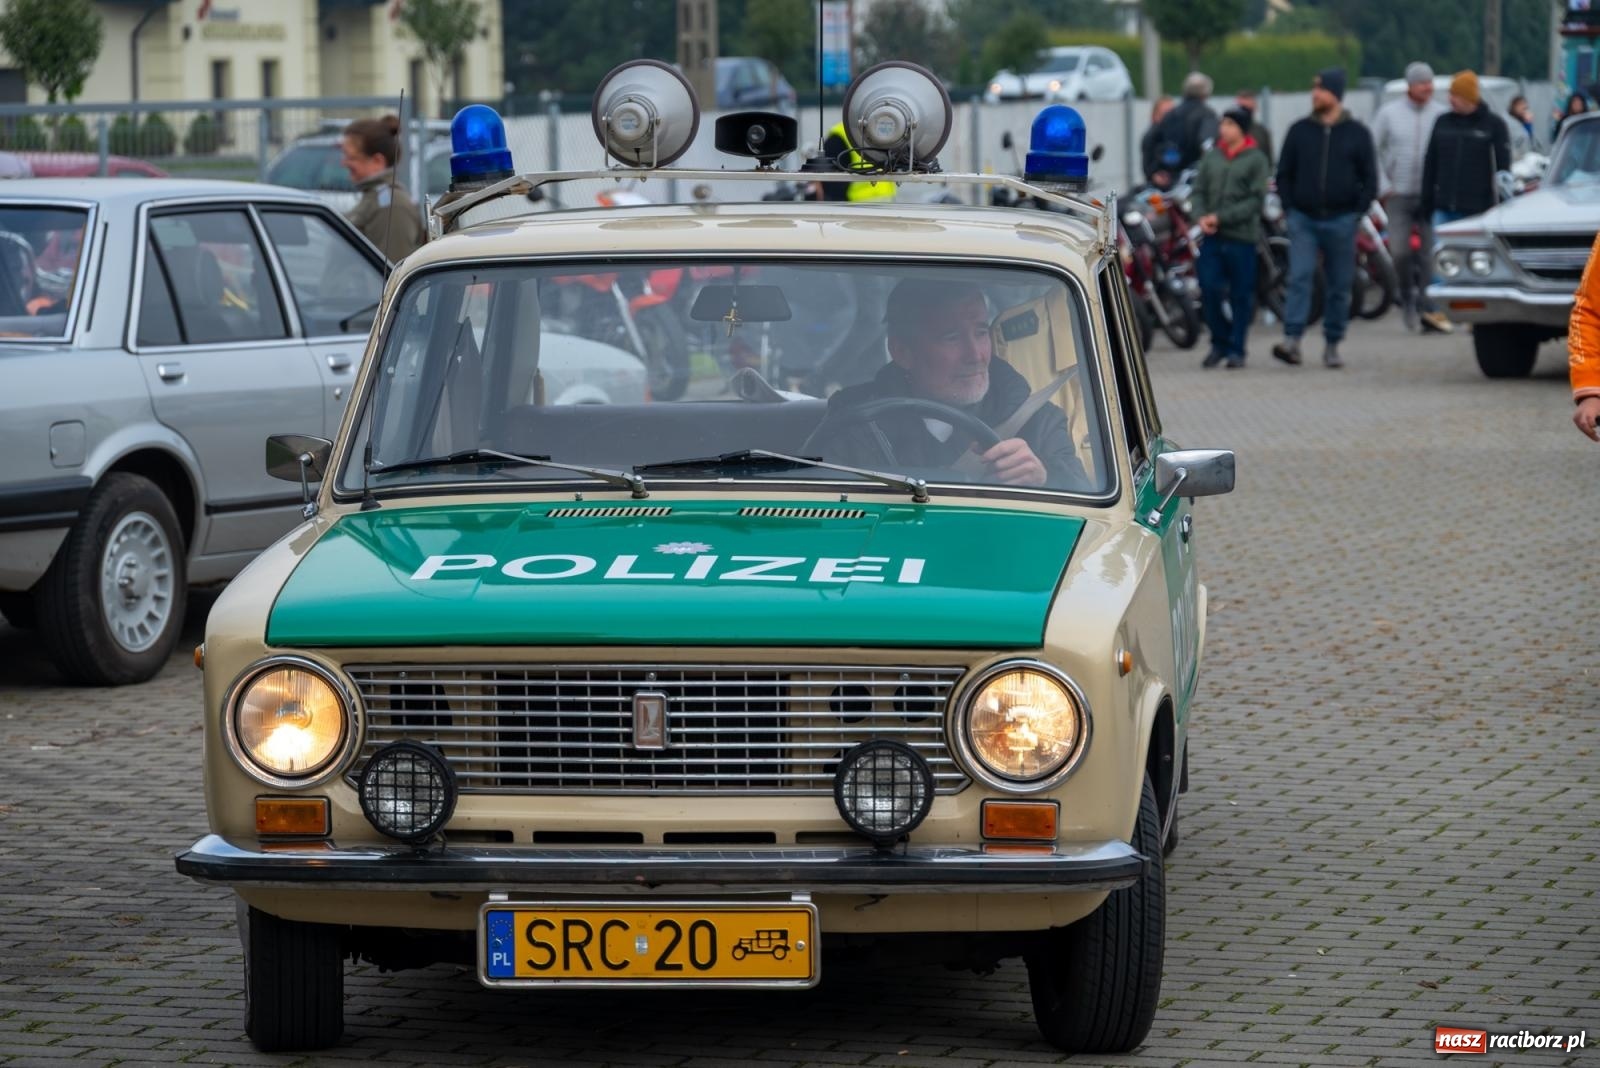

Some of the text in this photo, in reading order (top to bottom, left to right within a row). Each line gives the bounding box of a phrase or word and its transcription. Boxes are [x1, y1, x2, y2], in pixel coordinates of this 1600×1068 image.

[410, 554, 926, 584] POLIZEI
[492, 953, 511, 967] PL
[526, 919, 718, 971] SRC 20
